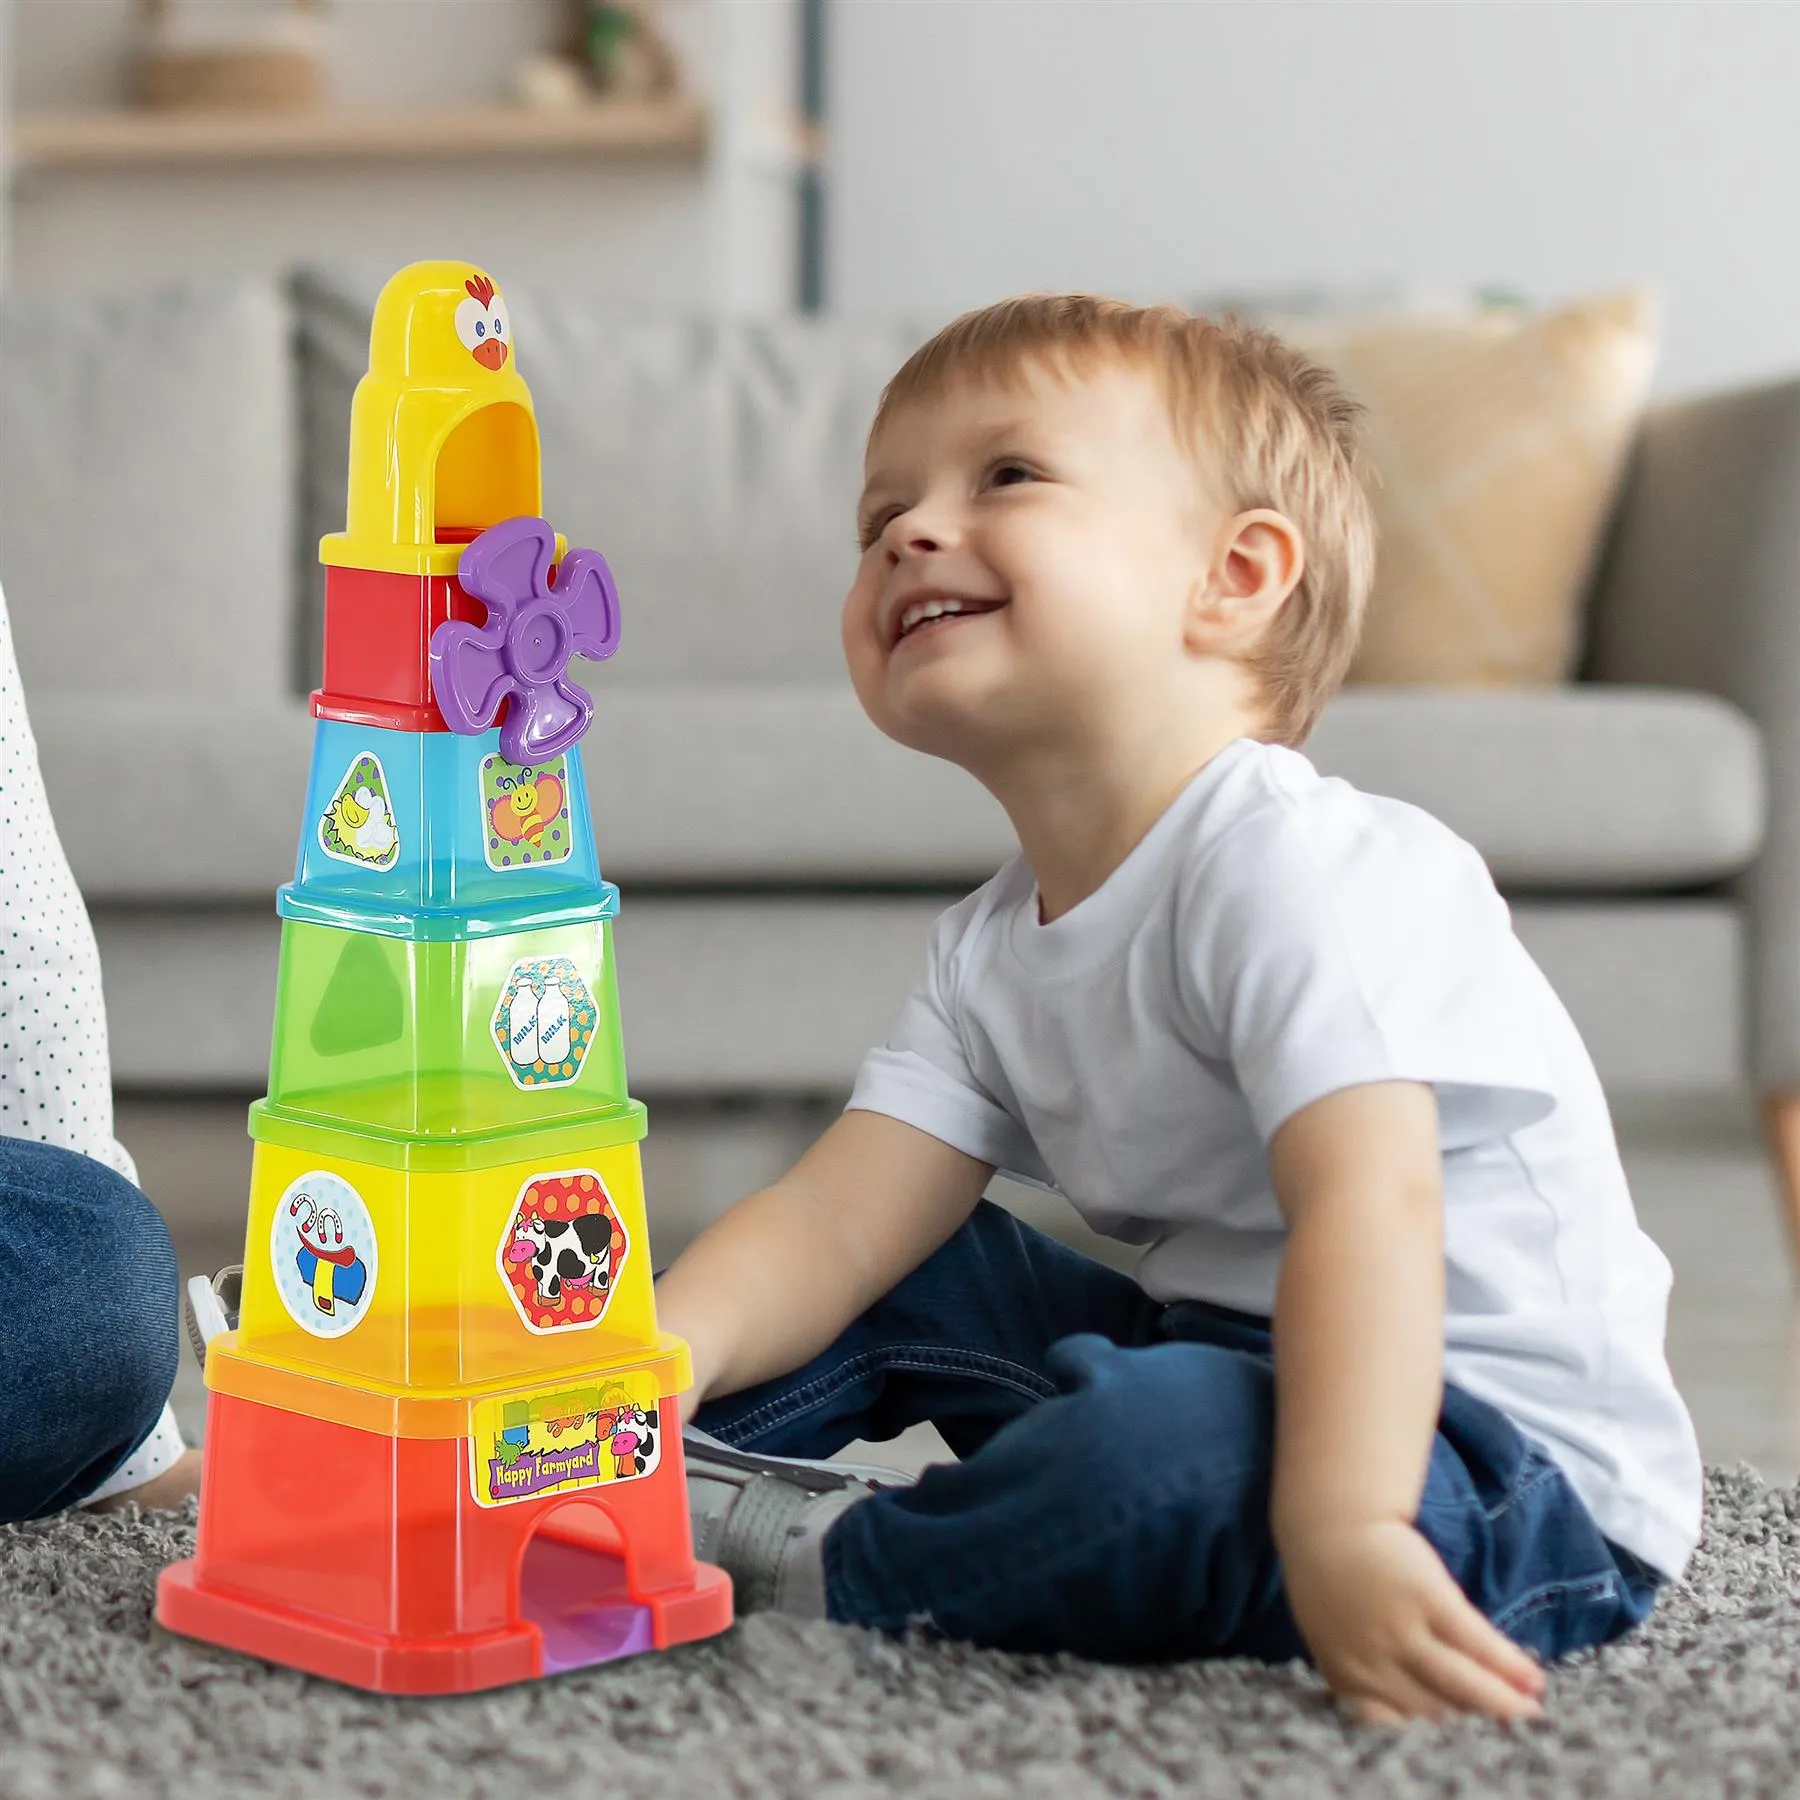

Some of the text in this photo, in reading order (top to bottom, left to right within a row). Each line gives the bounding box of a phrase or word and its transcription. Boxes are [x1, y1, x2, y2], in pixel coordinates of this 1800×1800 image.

[513, 1014, 537, 1045] MILK
[541, 1014, 567, 1044] MILK
[496, 1448, 594, 1488] Happy Farmyard
